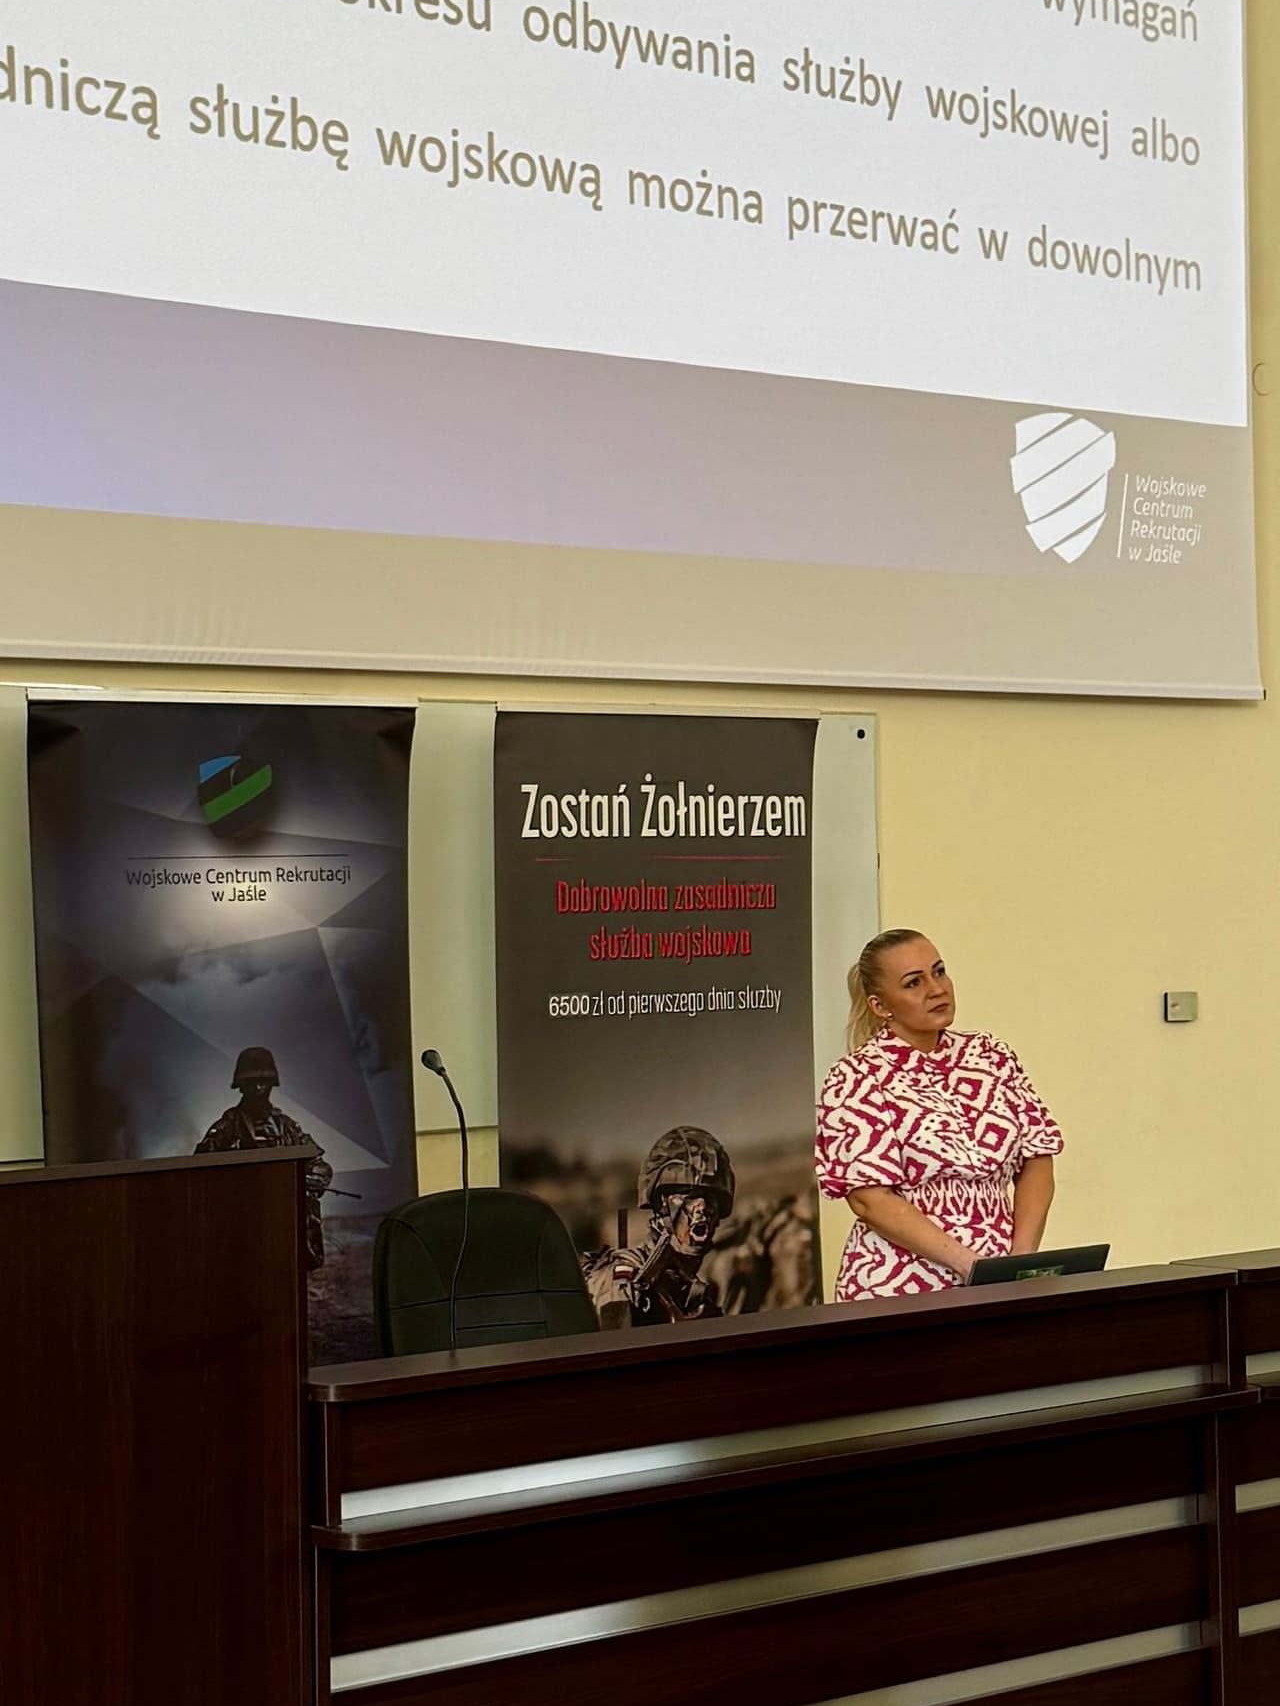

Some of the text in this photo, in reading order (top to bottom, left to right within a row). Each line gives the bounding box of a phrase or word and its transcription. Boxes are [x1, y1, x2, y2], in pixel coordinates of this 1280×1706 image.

[782, 46, 903, 122] służby
[924, 84, 1109, 161] wojskowej
[1131, 116, 1200, 166] albo
[189, 82, 349, 172] służbę
[375, 127, 604, 212] wojskową
[628, 168, 763, 225] można
[787, 196, 960, 255] przerwać
[977, 227, 1009, 262] w
[1027, 223, 1201, 296] dowolnym
[1136, 474, 1206, 498] Wojskowe
[1133, 497, 1193, 518] Centrum
[1130, 519, 1202, 546] Rekrutacji
[1128, 544, 1181, 564] w Jaśle
[520, 772, 807, 839] Zostań Żołnierzem
[126, 865, 352, 888] Wojskowe Centrum Rekrutacji
[211, 885, 268, 902] w Jaśle
[555, 876, 777, 914] Dobrowolna zasadnicza
[588, 924, 752, 966] służba wojskowa
[548, 995, 590, 1017] 6500
[591, 990, 605, 1016] zł
[607, 990, 625, 1015] od
[628, 991, 705, 1020] pierwszego
[707, 985, 736, 1011] dnia
